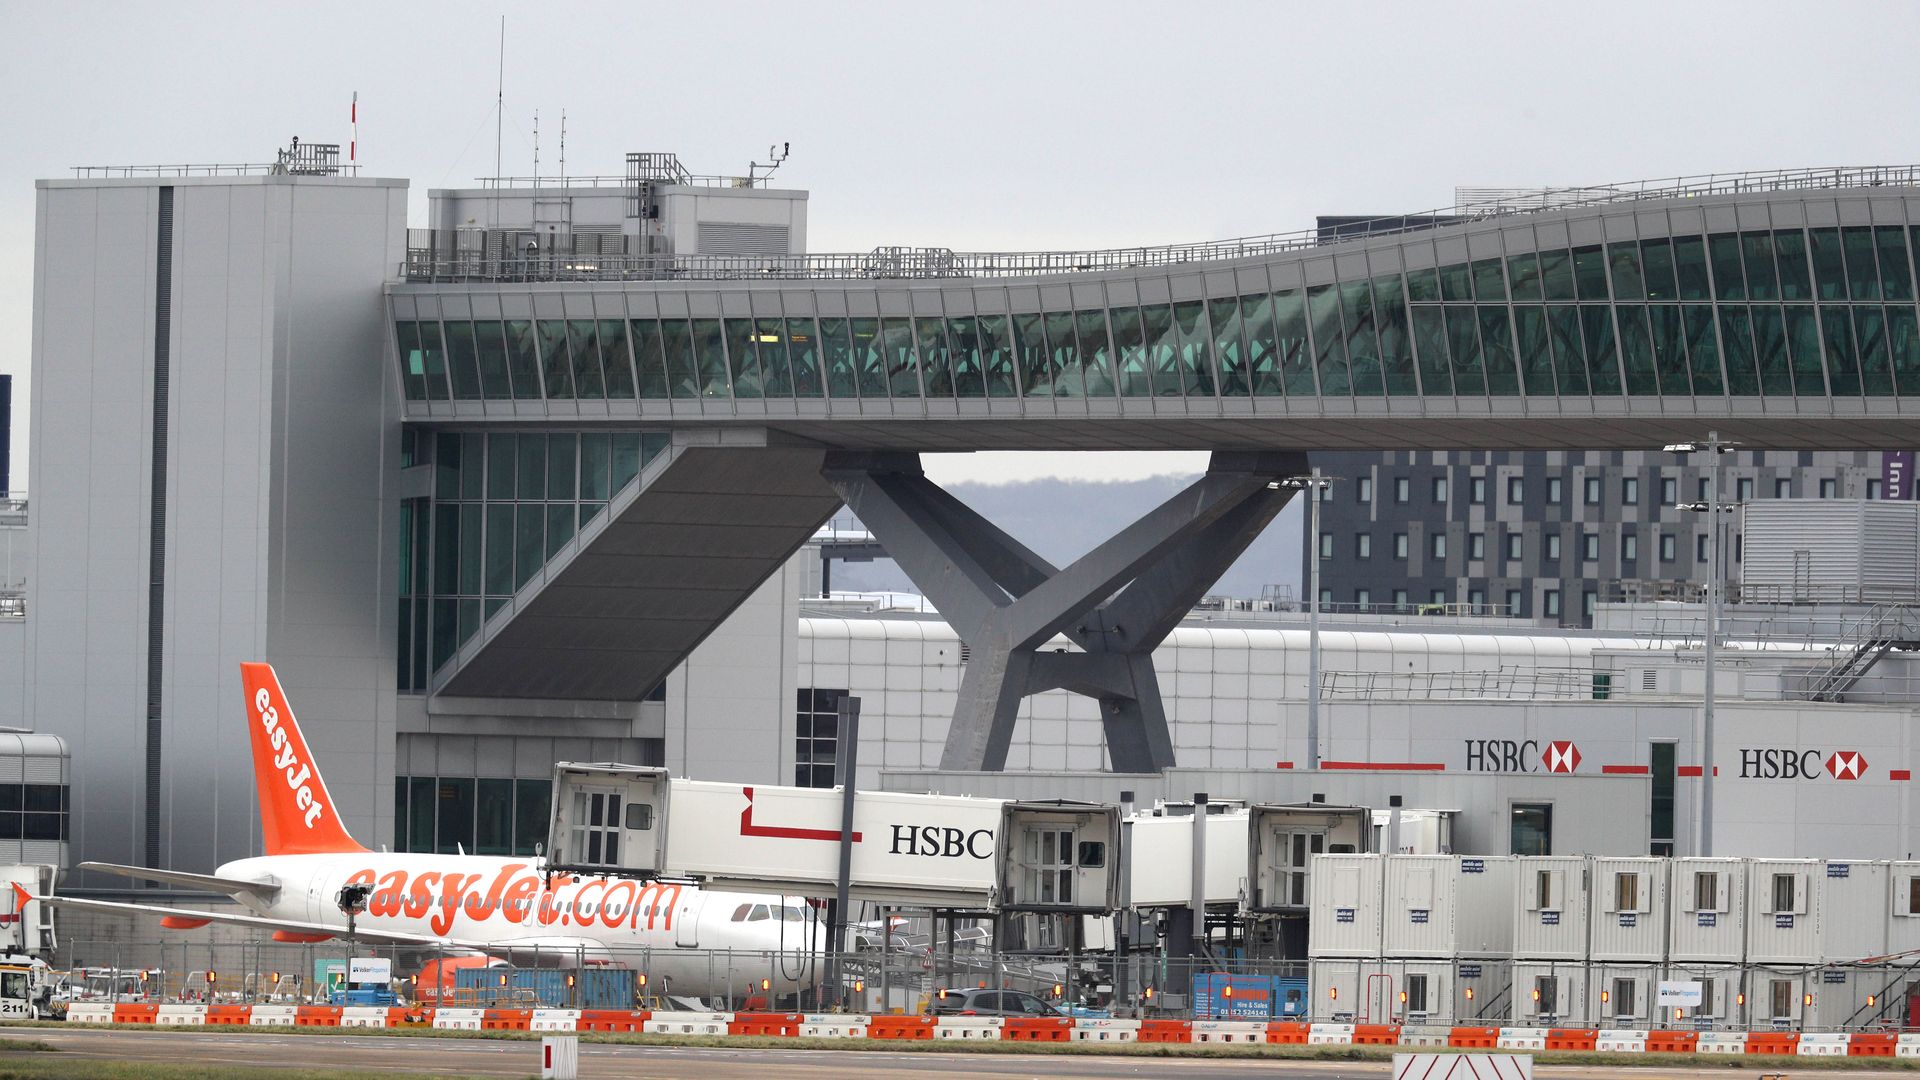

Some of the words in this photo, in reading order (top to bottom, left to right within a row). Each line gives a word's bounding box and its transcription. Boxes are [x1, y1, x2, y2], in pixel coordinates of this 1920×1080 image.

[255, 688, 323, 829] easyJet
[1465, 739, 1538, 772] HSBC
[1739, 749, 1821, 780] HSBC
[888, 824, 994, 860] HSBC
[425, 984, 456, 997] easJe
[2, 1004, 23, 1013] 211
